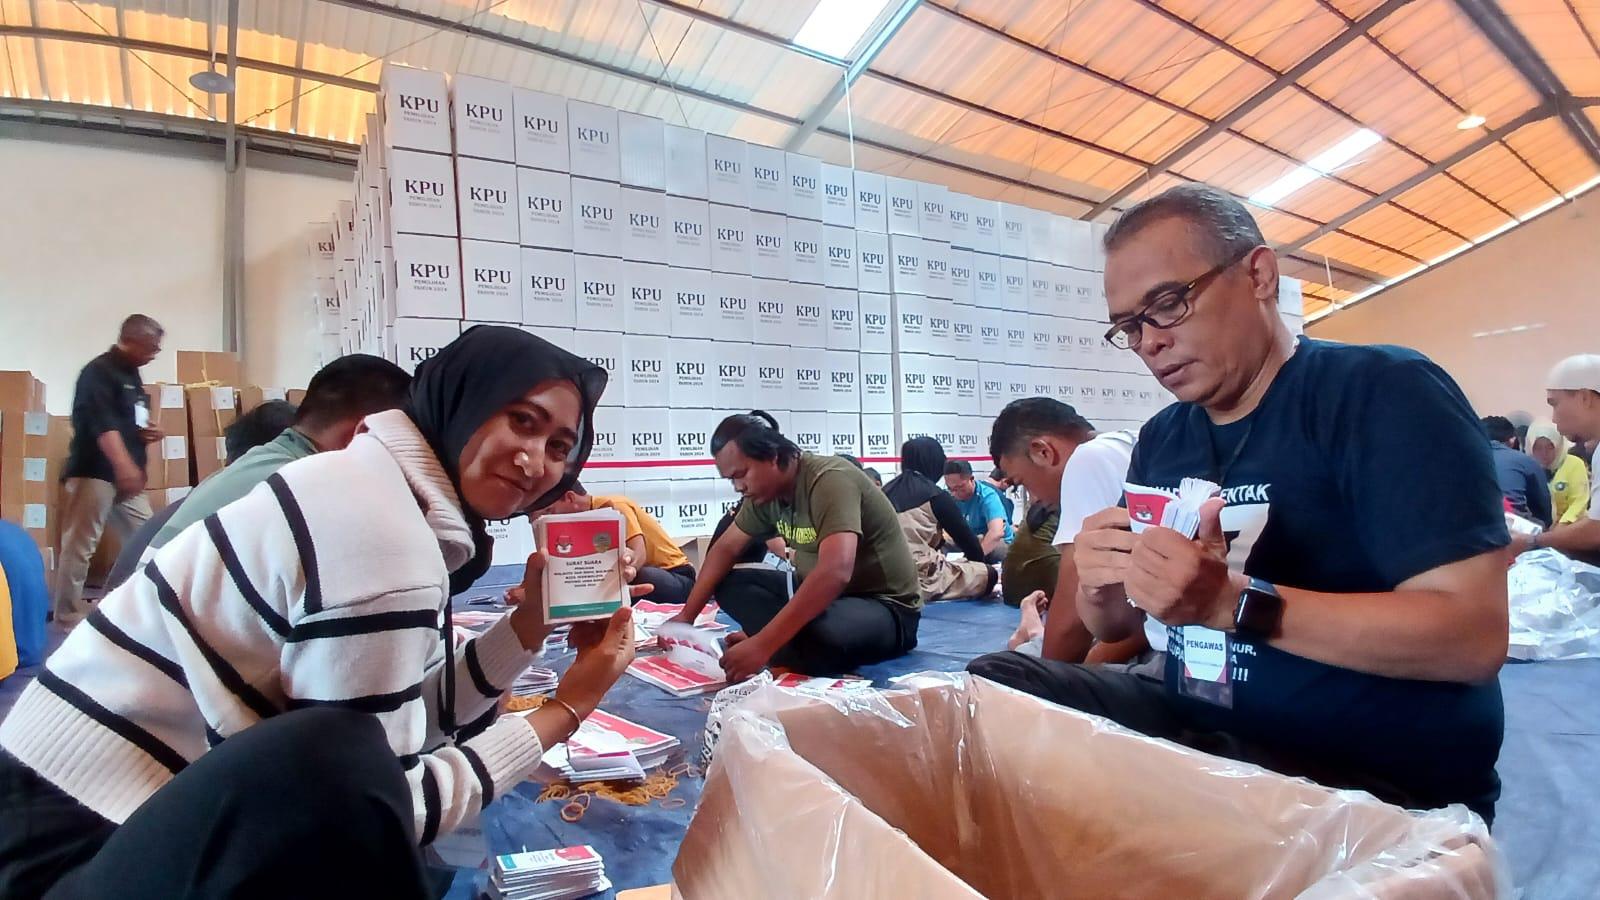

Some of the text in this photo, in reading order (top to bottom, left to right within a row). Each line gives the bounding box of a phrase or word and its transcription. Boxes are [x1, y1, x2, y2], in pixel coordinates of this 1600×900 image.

[400, 94, 439, 112] KPU
[466, 104, 502, 121] KPU
[524, 116, 559, 133] KPU
[578, 128, 609, 144] KPU
[714, 159, 741, 174] KPU
[755, 168, 779, 182] KPU
[405, 179, 444, 196] KPU
[793, 176, 816, 189] KPU
[470, 187, 507, 203] KPU
[825, 184, 848, 197] KPU
[528, 196, 561, 212] KPU
[860, 192, 881, 204] KPU
[892, 197, 912, 209] KPU
[581, 205, 612, 220] KPU
[924, 202, 943, 214] KPU
[630, 213, 659, 228] KPU
[951, 210, 968, 222] KPU
[977, 217, 994, 228] KPU
[674, 222, 702, 236] KPU
[718, 229, 744, 242] KPU
[756, 236, 781, 248] KPU
[794, 242, 817, 254] KPU
[829, 247, 851, 259] KPU
[863, 253, 884, 264] KPU
[898, 256, 918, 267] KPU
[928, 260, 946, 271] KPU
[410, 263, 449, 278] KPU
[474, 269, 511, 283] KPU
[951, 268, 970, 278] KPU
[531, 276, 565, 290] KPU
[979, 272, 996, 282] KPU
[1007, 275, 1023, 285] KPU
[584, 282, 615, 296] KPU
[632, 287, 662, 300] KPU
[677, 293, 705, 306] KPU
[720, 297, 746, 309] KPU
[758, 301, 783, 314] KPU
[796, 306, 819, 318] KPU
[832, 310, 853, 321] KPU
[865, 314, 886, 326] KPU
[902, 313, 922, 325] KPU
[930, 318, 949, 329] KPU
[954, 323, 972, 334] KPU
[981, 327, 998, 337] KPU
[1008, 329, 1024, 339] KPU
[1034, 333, 1050, 342] KPU
[1057, 335, 1072, 344] KPU
[410, 347, 441, 361] KP
[585, 357, 616, 370] PU
[632, 360, 661, 372] KPU
[677, 362, 705, 374] KPU
[719, 366, 746, 377] KPU
[759, 368, 784, 379] KPU
[797, 369, 820, 381] KPU
[832, 372, 853, 383] KPU
[866, 374, 886, 385] KPU
[906, 374, 925, 384] KPU
[933, 376, 951, 386] KPU
[956, 380, 975, 389] KPU
[984, 382, 1001, 391] KPU
[1010, 384, 1026, 392] KPU
[1059, 386, 1073, 394] KPU
[594, 433, 616, 445] PU
[632, 433, 662, 445] KPU
[677, 433, 706, 445] KPU
[798, 434, 821, 444] KPU
[833, 435, 854, 445] KPU
[868, 435, 889, 445] KPU
[936, 434, 954, 444] KPU
[959, 435, 977, 444] KPU
[1221, 484, 1271, 502] ENTAK
[643, 506, 664, 518] PU
[679, 504, 707, 517] KPU
[1186, 640, 1223, 651] PENGAWAS
